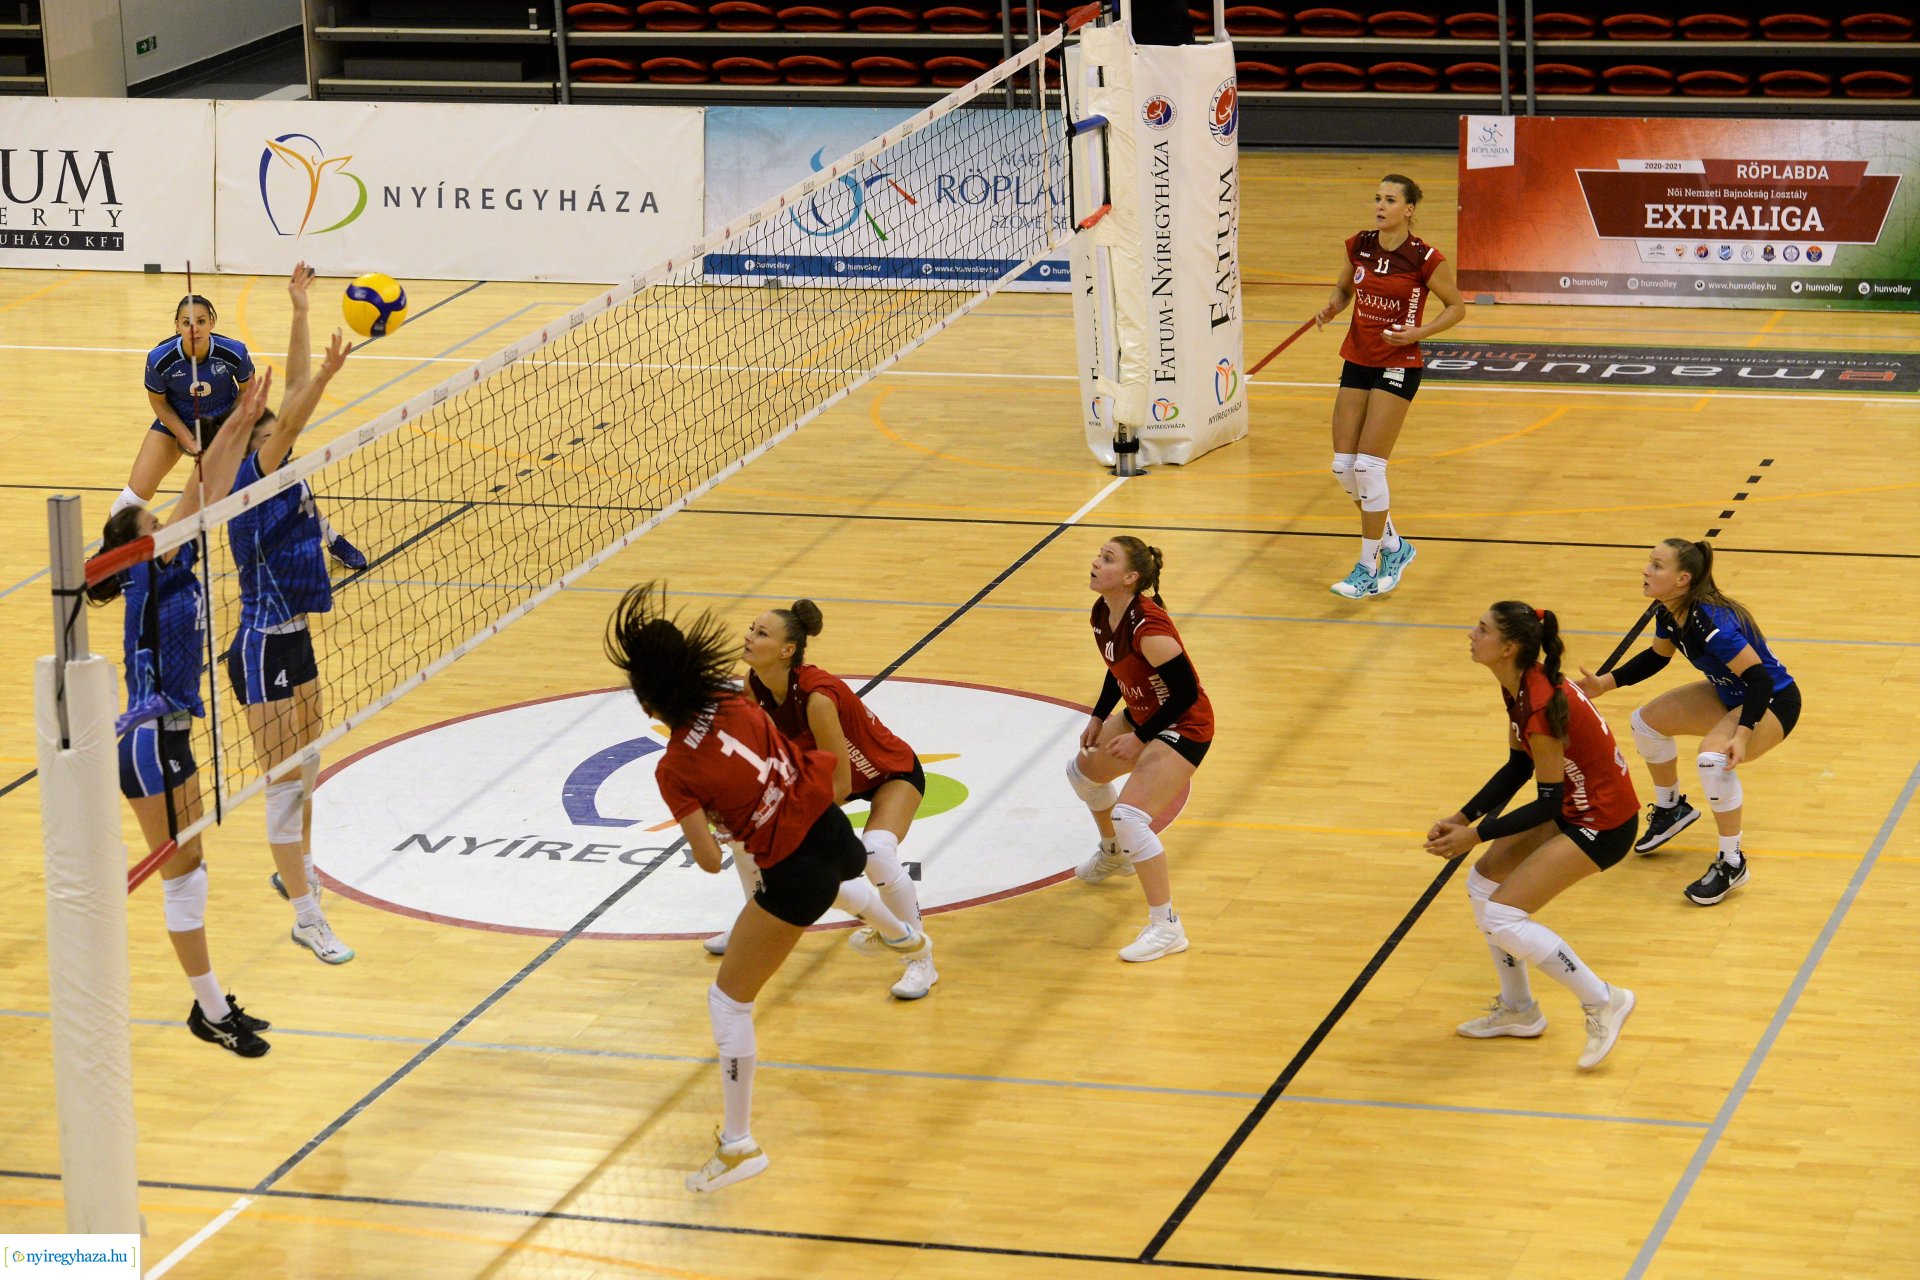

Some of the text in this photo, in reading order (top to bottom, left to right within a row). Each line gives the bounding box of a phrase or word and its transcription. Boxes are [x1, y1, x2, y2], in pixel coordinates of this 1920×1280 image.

[0, 149, 123, 206] UM
[1737, 162, 1829, 180] RÖPLABDA
[937, 168, 1066, 206] RÖPLA
[1667, 188, 1682, 197] Női
[1684, 189, 1721, 197] Nemzeti
[1723, 189, 1768, 200] Bajnokság
[383, 181, 659, 213] NYÍREGYHÁZA
[1645, 204, 1825, 232] EXTRALIGA
[85, 236, 123, 248] KFT
[1209, 165, 1235, 335] FATUM
[1374, 257, 1390, 274] 11
[1572, 278, 1609, 288] hunvolley
[1641, 279, 1677, 289] hunvolley
[1708, 281, 1777, 291] www.hunvolley.hu
[1806, 283, 1843, 293] hunvolley
[1874, 284, 1912, 295] hunvolley
[1356, 288, 1400, 309] FATUM
[1209, 401, 1242, 426] NYÍREGYHÁZA
[273, 669, 288, 687] 4
